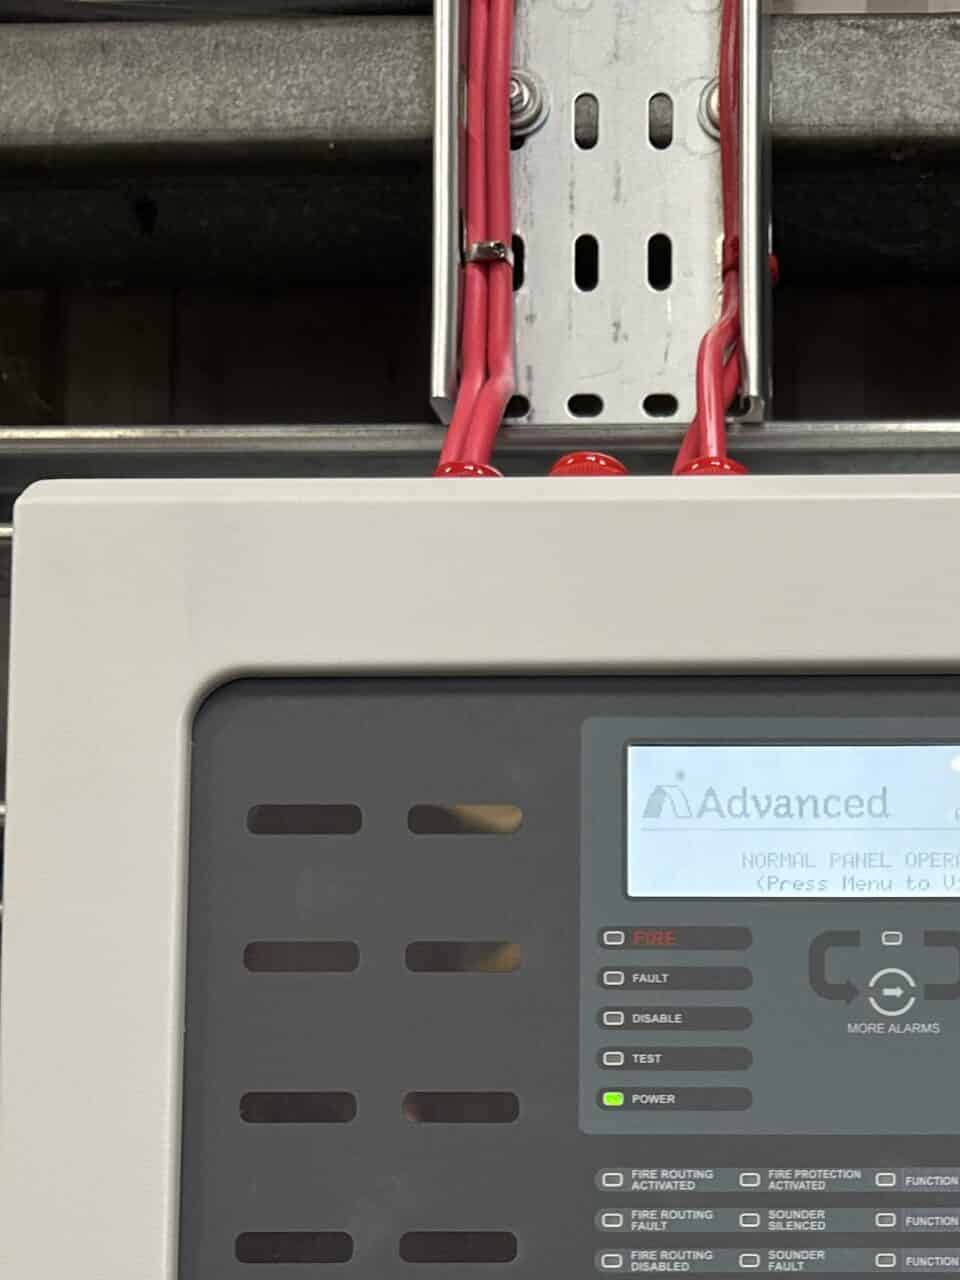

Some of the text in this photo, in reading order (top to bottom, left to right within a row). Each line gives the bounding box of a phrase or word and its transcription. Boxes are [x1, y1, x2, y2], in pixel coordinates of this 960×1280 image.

[696, 785, 889, 819] Advanced
[741, 851, 817, 869] NORMAL
[829, 851, 893, 868] PANEL
[756, 875, 828, 892] (Press
[842, 875, 893, 891] Menu
[906, 875, 930, 891] to
[633, 931, 676, 945] FIRE
[632, 973, 669, 983] FAULT
[632, 1014, 683, 1024] DISABLE
[847, 1023, 940, 1034] MORE ALARMS
[632, 1054, 662, 1064] TEST
[631, 1094, 676, 1104] POWER
[631, 1169, 714, 1180] FIRE ROUTING
[768, 1169, 862, 1179] FIRE PROTECTION
[631, 1180, 696, 1191] ACTIVATED
[768, 1180, 826, 1191] ACTIVATED
[905, 1176, 959, 1186] FUNCTION
[631, 1209, 713, 1220] FIRE ROUTING
[768, 1209, 826, 1219] SOUNDER
[631, 1221, 667, 1231] FAULT
[768, 1221, 826, 1231] SILENCED
[905, 1216, 959, 1226] FUNCTION
[631, 1250, 713, 1260] FIRE ROUTING
[768, 1250, 825, 1260] SOUNDER
[631, 1262, 690, 1272] DISABLED
[768, 1262, 805, 1272] FAULT
[905, 1257, 959, 1267] FUNCTION
